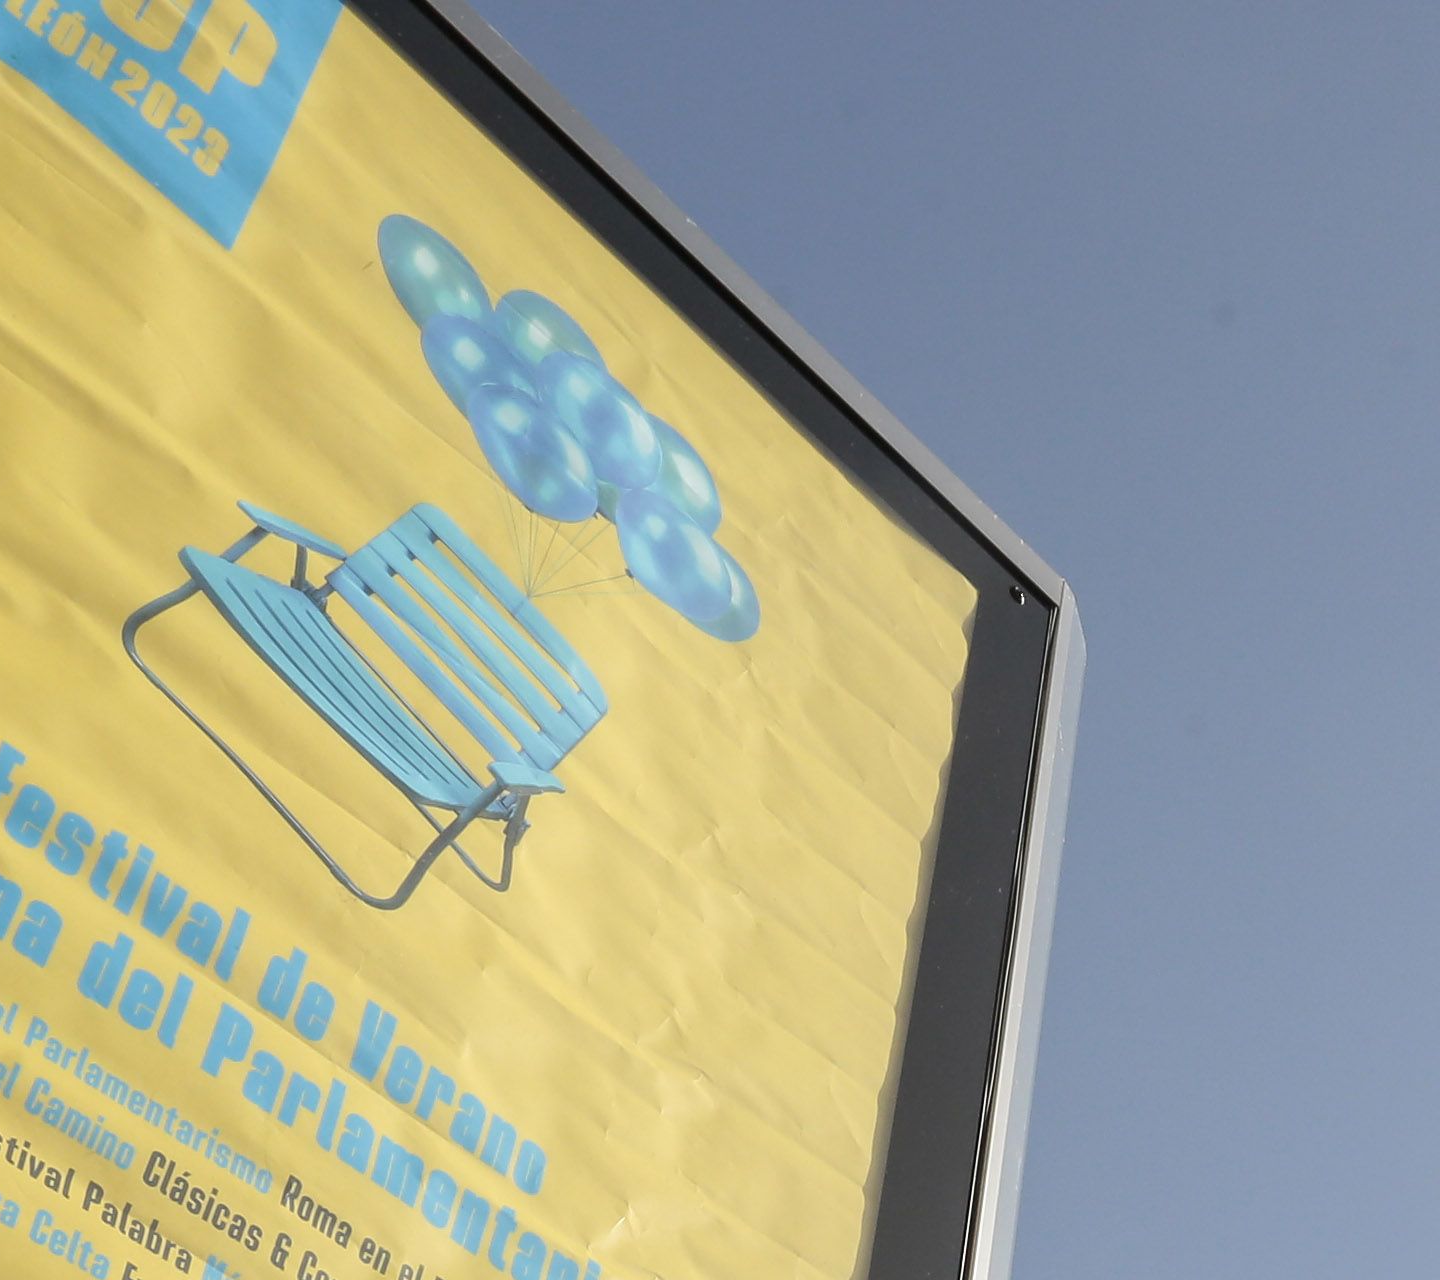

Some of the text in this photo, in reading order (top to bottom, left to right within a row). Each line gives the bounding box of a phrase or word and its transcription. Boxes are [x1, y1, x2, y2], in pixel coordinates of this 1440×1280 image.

[110, 60, 231, 178] 2023
[77, 932, 196, 1048] del
[256, 948, 337, 1041] de
[350, 1000, 548, 1196] Verano
[23, 1016, 274, 1194] Parlamentarismo
[280, 1174, 353, 1249] Roma
[358, 1237, 391, 1276] en
[24, 1077, 137, 1170] Camino
[142, 1150, 263, 1252] Clásicas
[270, 1232, 293, 1271] &
[28, 1209, 111, 1280] Celta
[82, 1179, 192, 1275] Palabra
